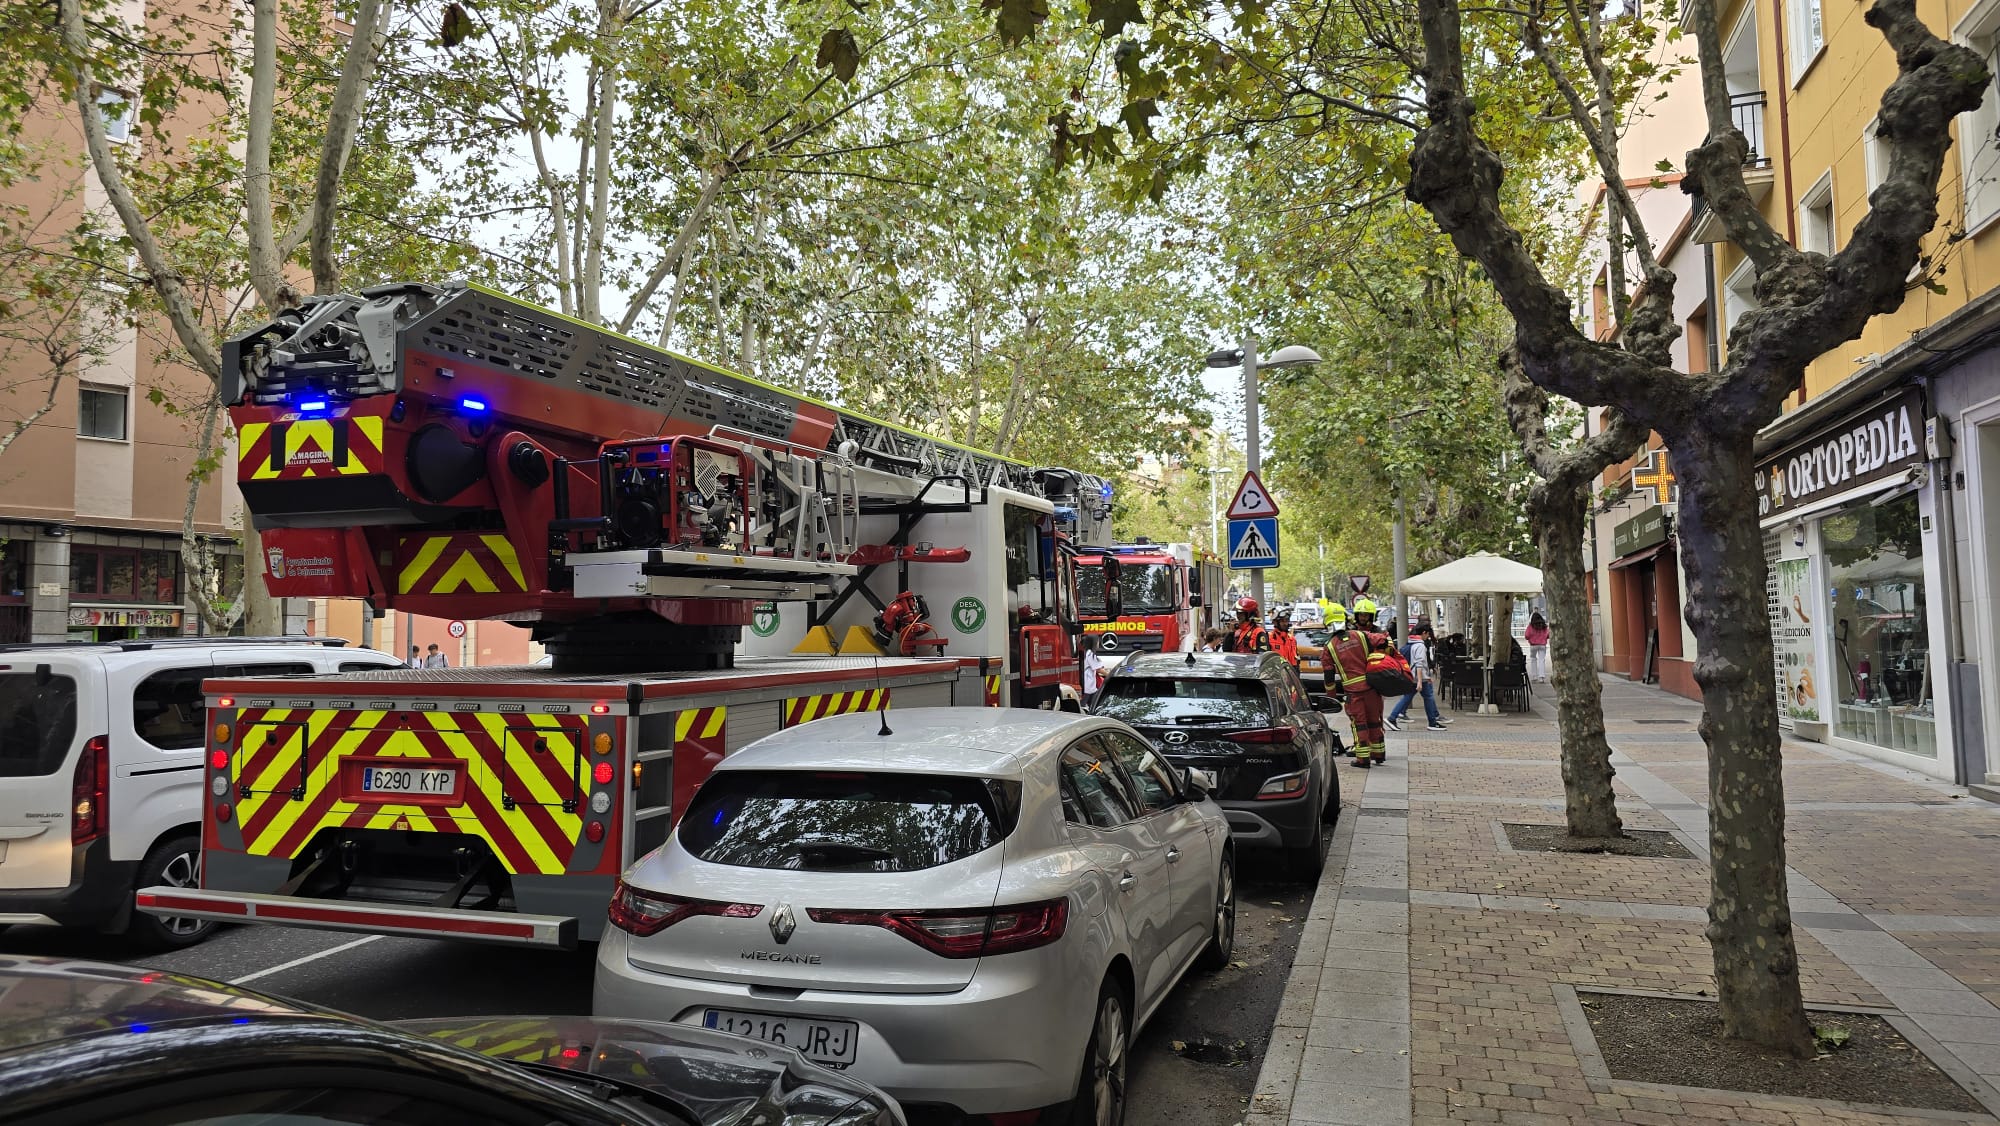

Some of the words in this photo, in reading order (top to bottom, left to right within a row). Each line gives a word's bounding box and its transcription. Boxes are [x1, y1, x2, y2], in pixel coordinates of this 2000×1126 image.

[1788, 405, 1918, 499] ORTOPEDIA
[104, 611, 120, 625] Mi
[126, 610, 174, 626] huerto
[452, 625, 463, 633] 30
[374, 771, 411, 790] 6290
[420, 772, 450, 791] KYP
[741, 949, 822, 965] MEGANE
